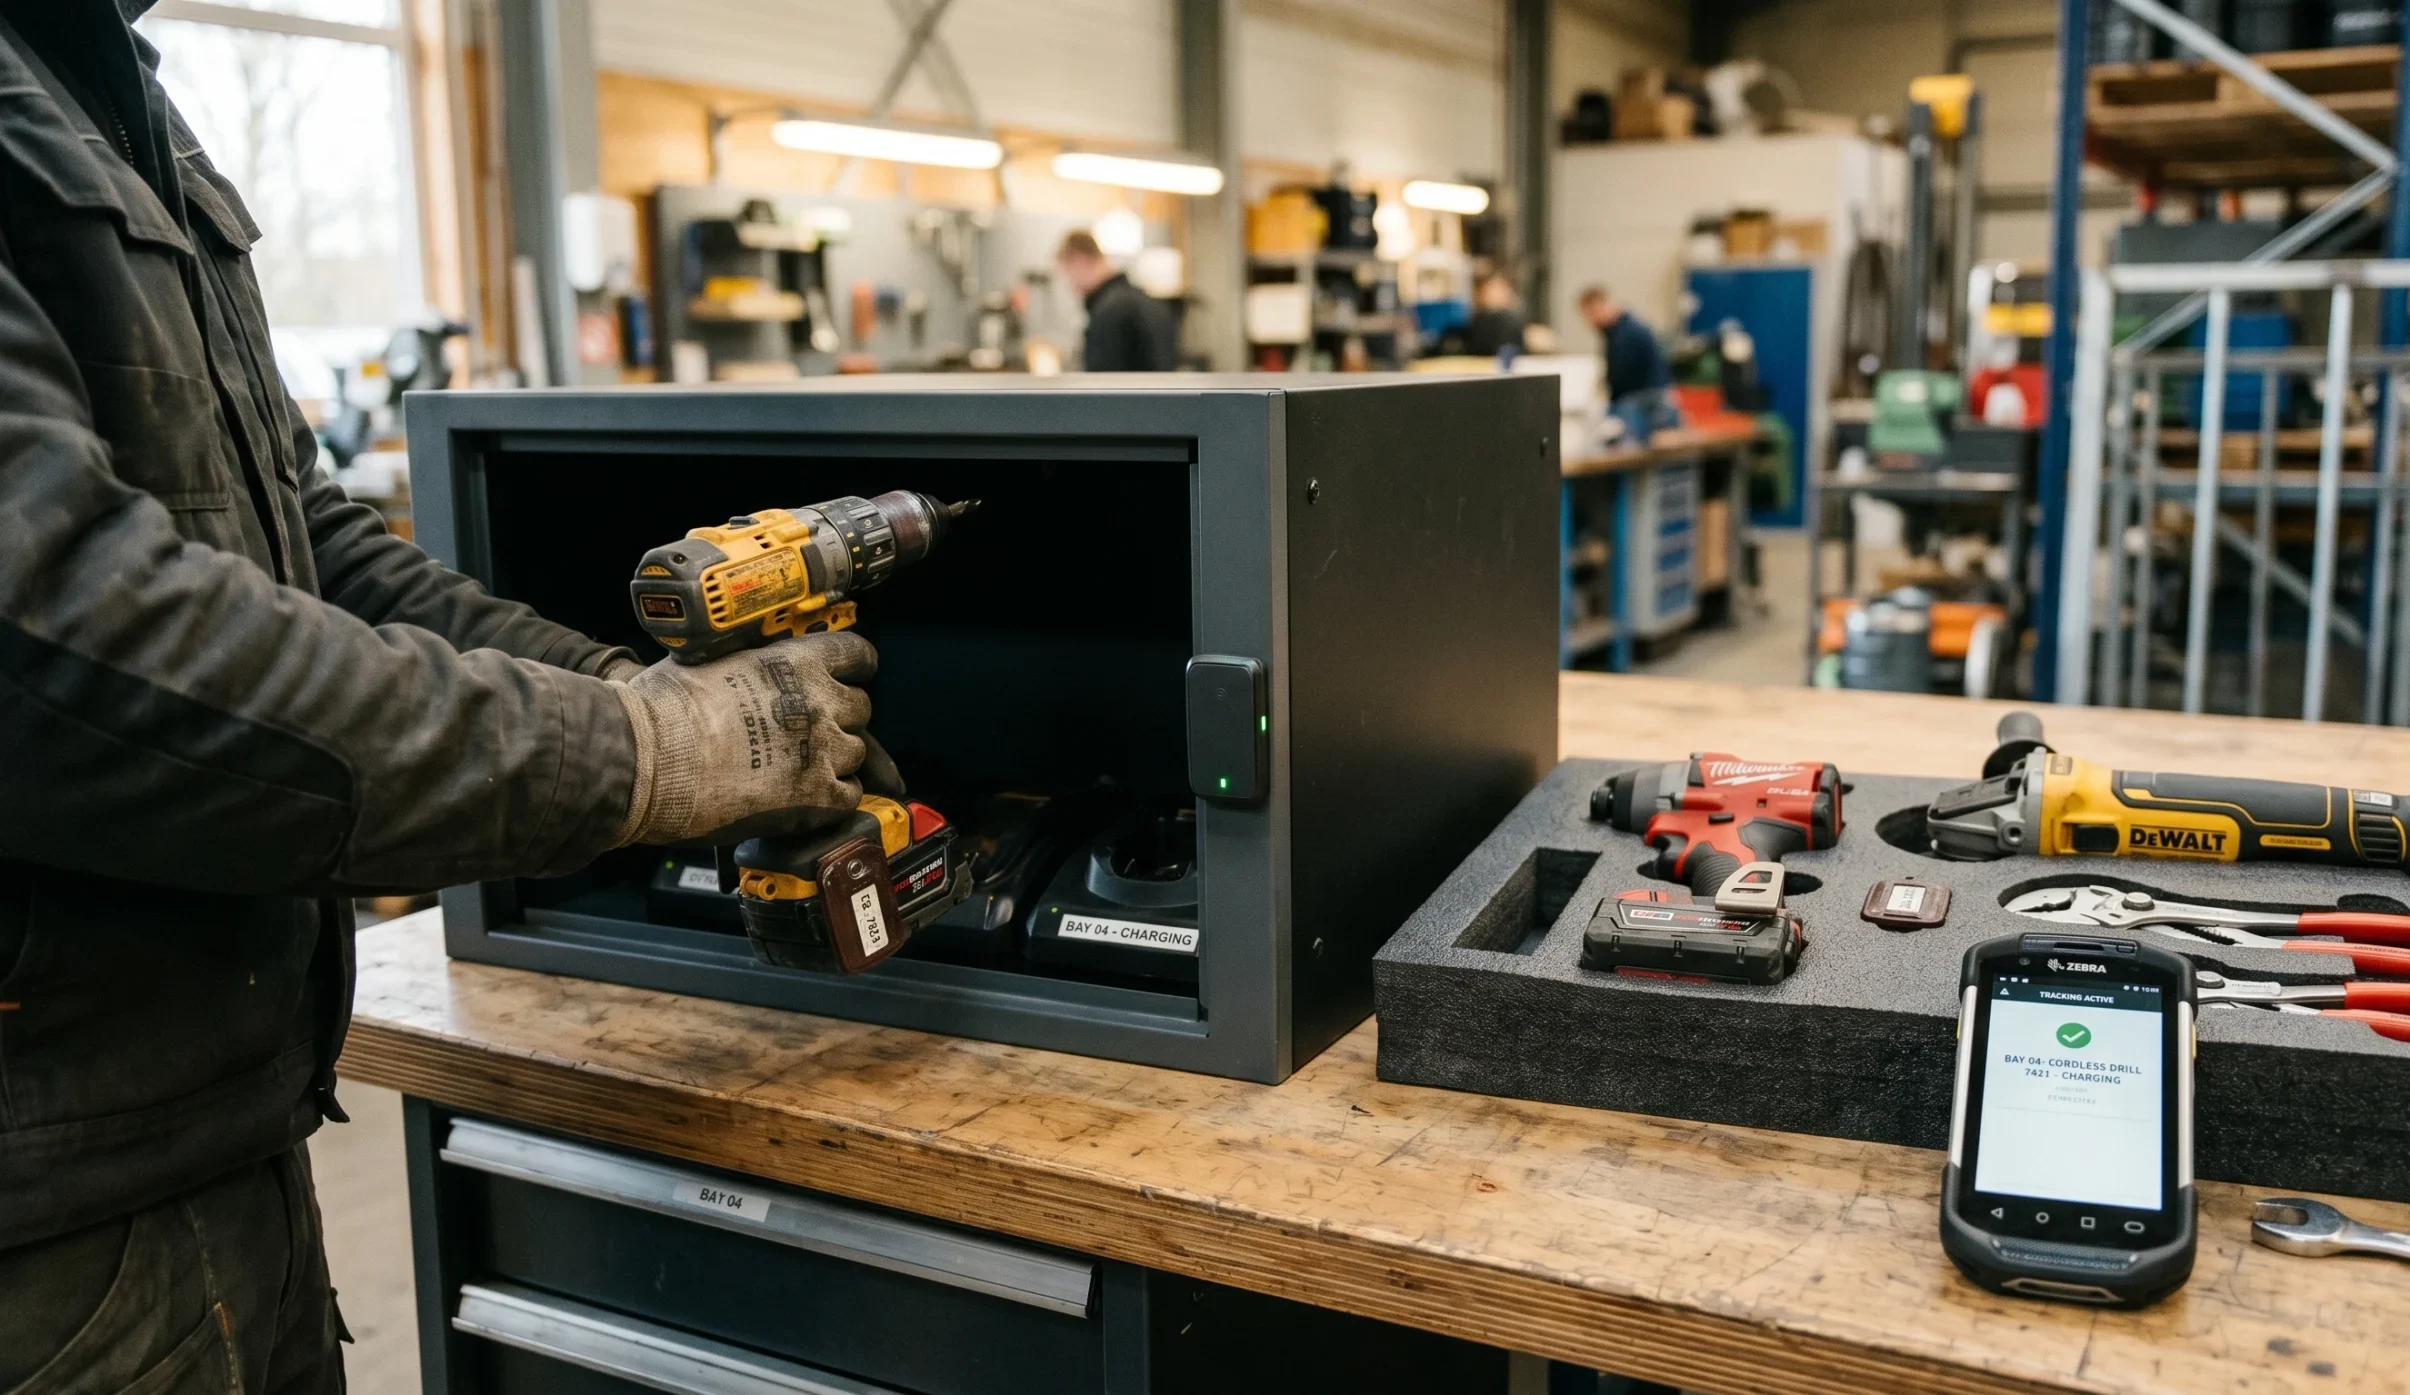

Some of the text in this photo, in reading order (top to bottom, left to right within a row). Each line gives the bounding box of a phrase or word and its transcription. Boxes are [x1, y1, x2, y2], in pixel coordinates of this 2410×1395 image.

[1065, 920, 1093, 933] BAY
[1094, 924, 1109, 936] 04
[1120, 927, 1193, 946] CHARGING
[2066, 962, 2108, 974] ZEBRA
[2083, 995, 2115, 1004] ACTIVE
[2004, 1054, 2026, 1064] BAY
[2048, 1058, 2107, 1072] CORDLESS
[2109, 1063, 2143, 1075] DRILL
[2025, 1068, 2050, 1078] 7421
[2062, 1071, 2122, 1085] CHARGING
[699, 1187, 743, 1210] BAY 04
